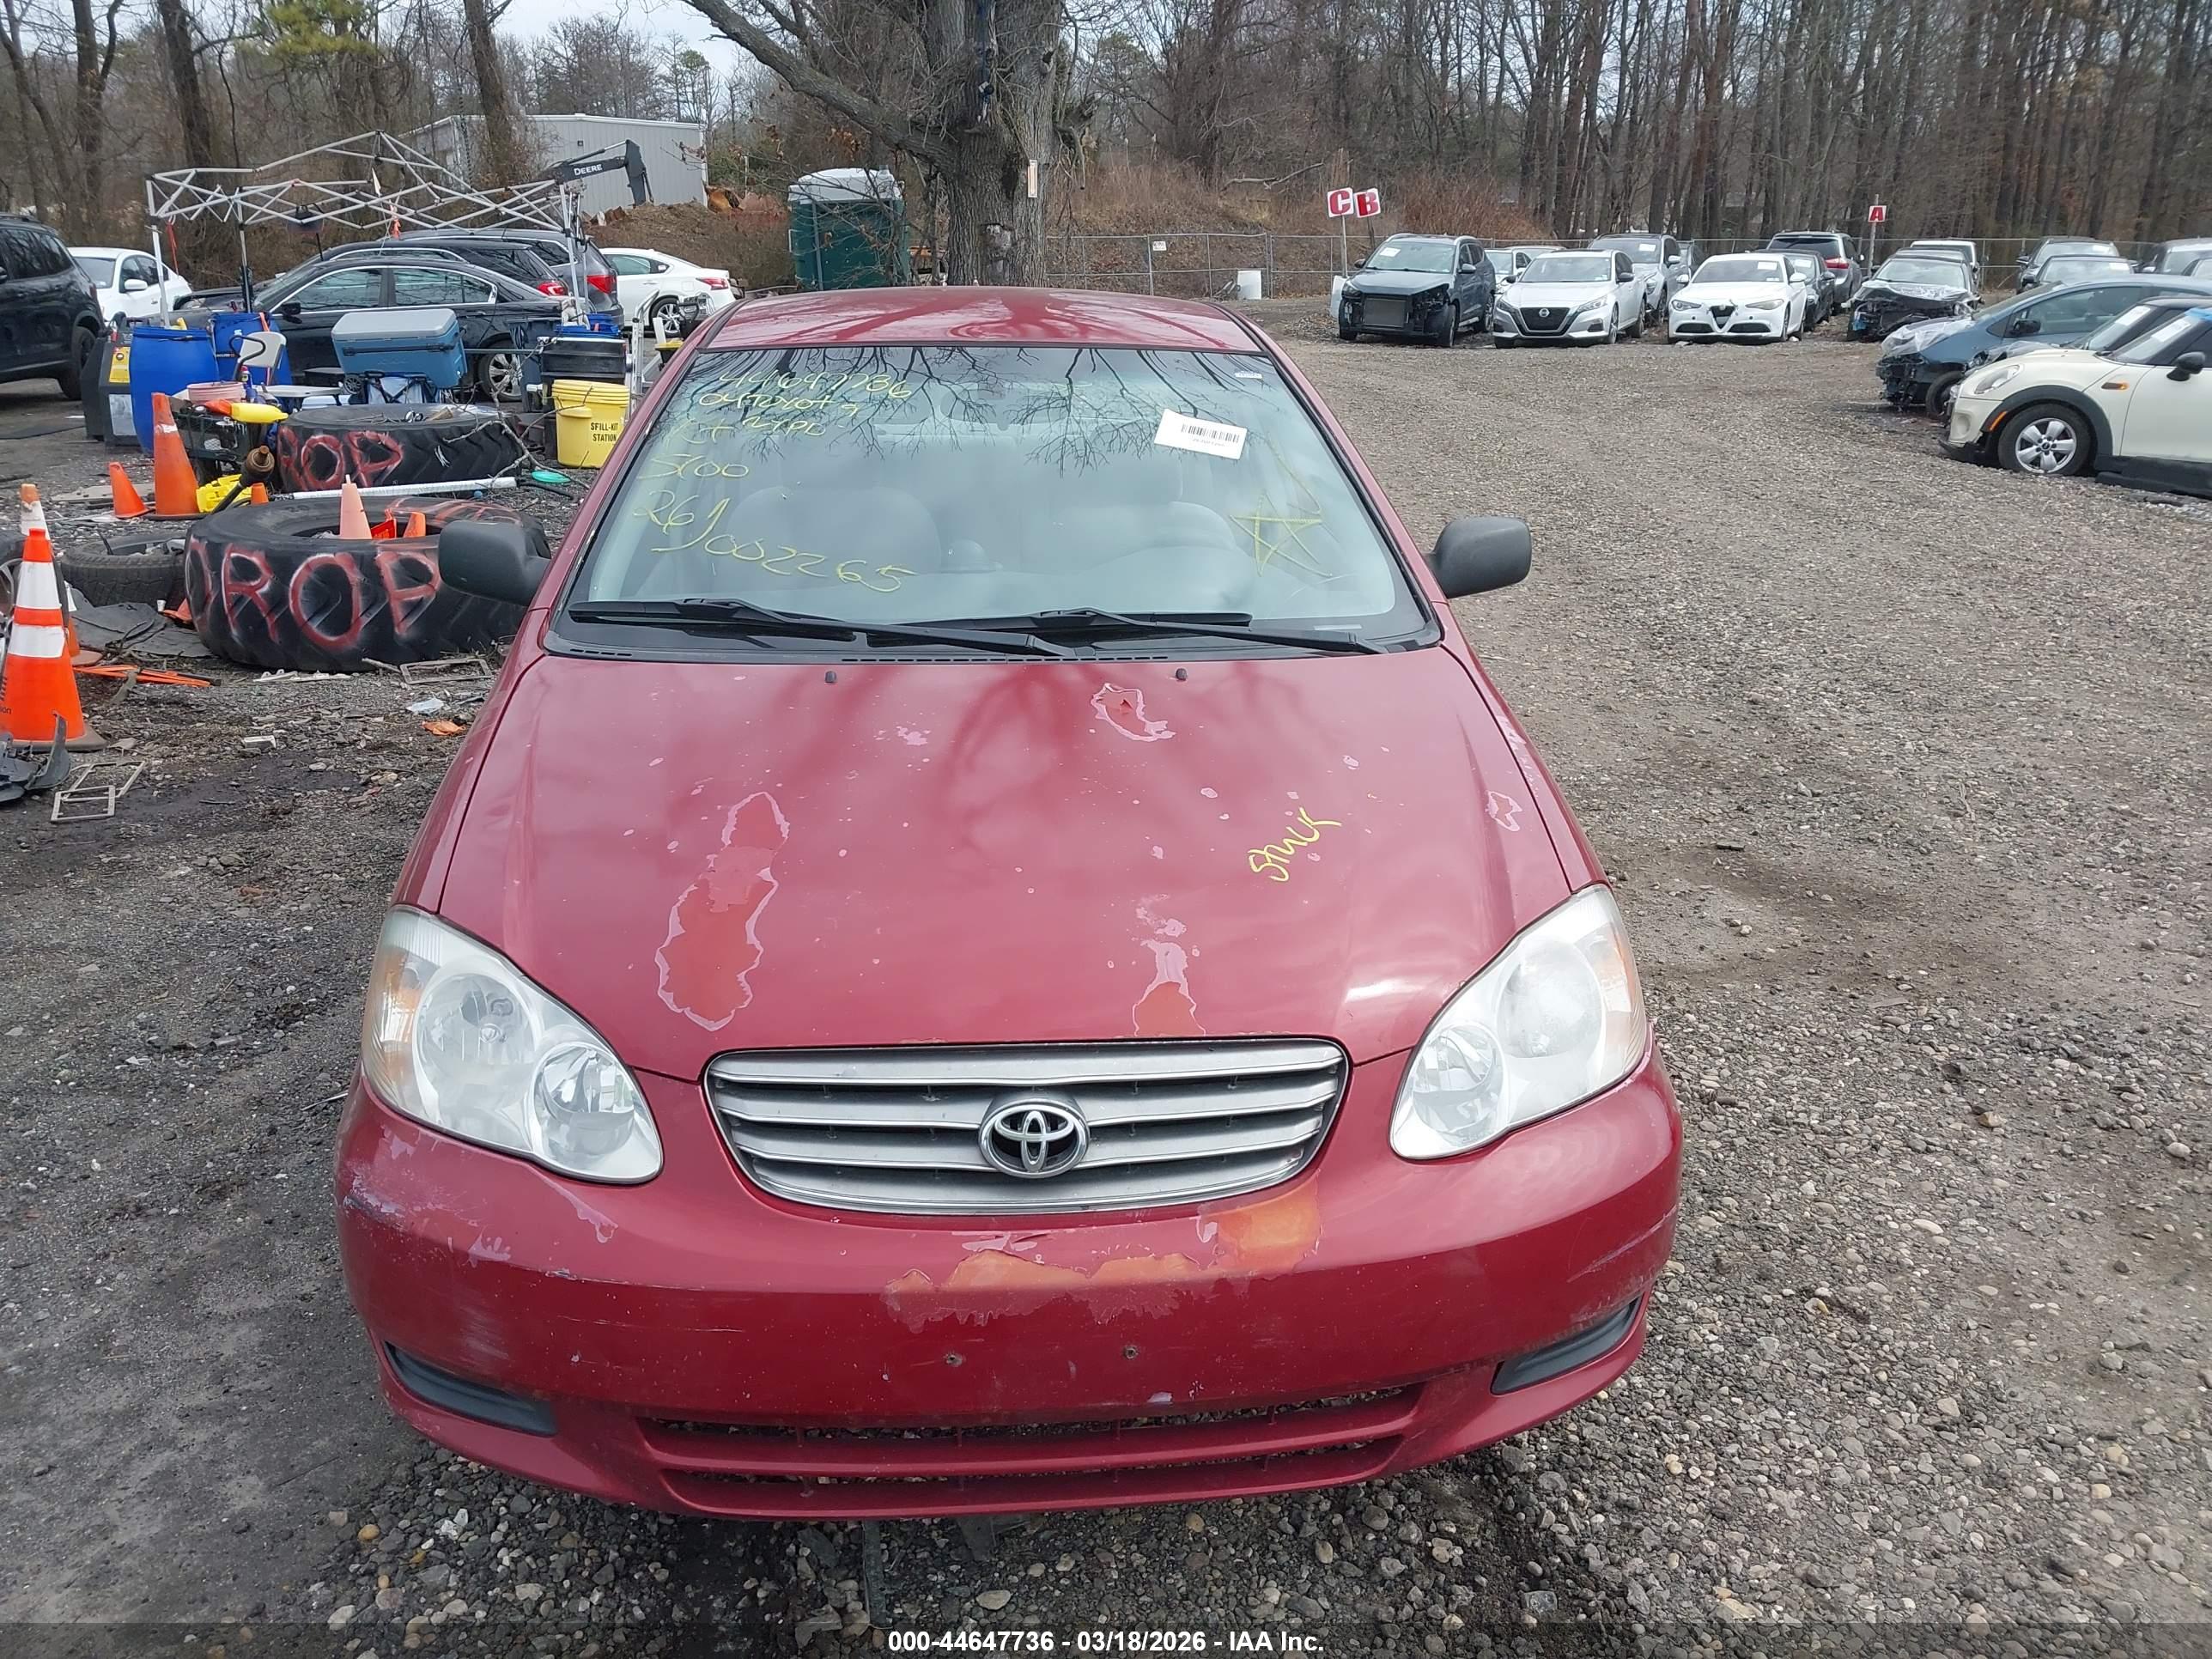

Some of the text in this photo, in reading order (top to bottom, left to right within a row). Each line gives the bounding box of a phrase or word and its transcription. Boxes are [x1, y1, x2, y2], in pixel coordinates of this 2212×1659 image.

[574, 164, 603, 176] DEERE
[1329, 190, 1351, 215] C
[1357, 191, 1379, 216] B
[1869, 206, 1884, 222] A
[592, 433, 617, 442] STATION
[185, 536, 441, 650] DROP
